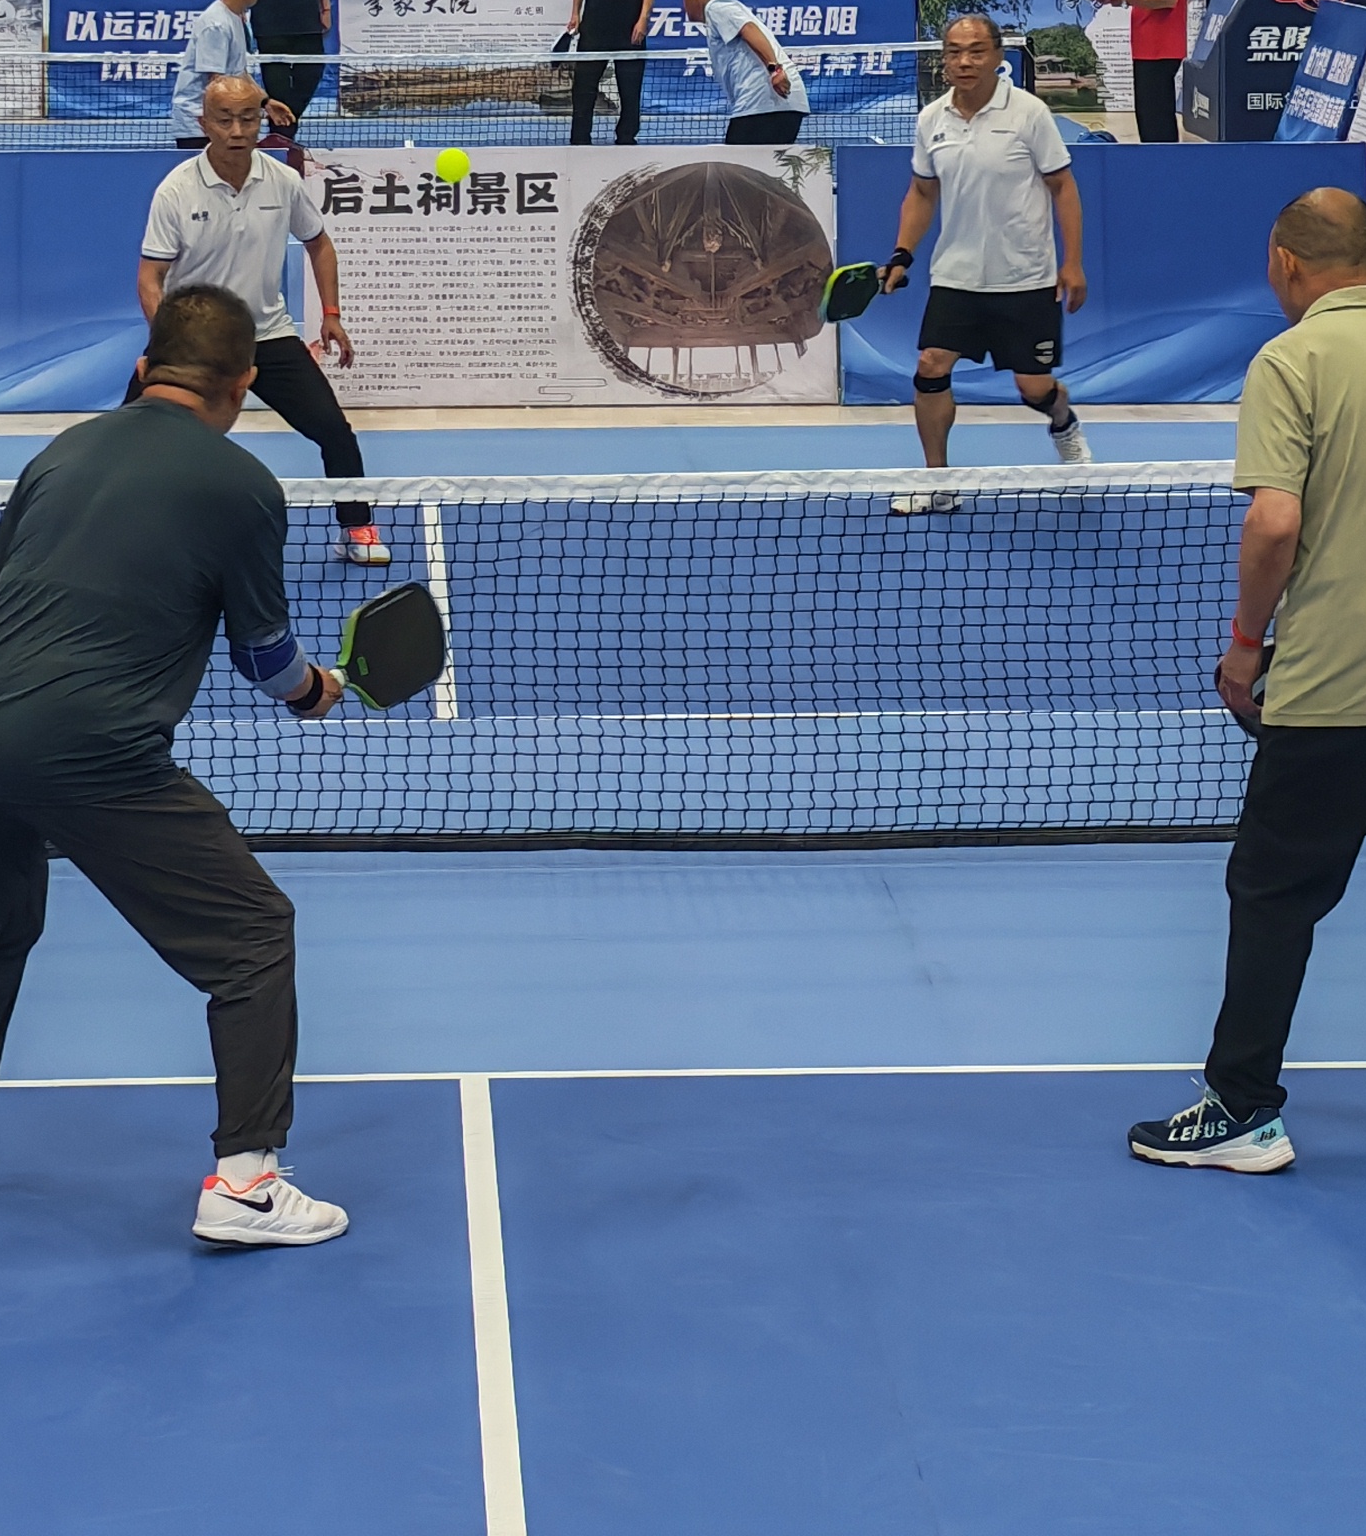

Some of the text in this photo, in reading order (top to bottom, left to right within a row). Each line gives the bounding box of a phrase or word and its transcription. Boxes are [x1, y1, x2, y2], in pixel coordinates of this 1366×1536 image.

[1246, 51, 1304, 62] JINLIN
[1247, 92, 1291, 111] 国际
[320, 171, 560, 216] 后土祠景区
